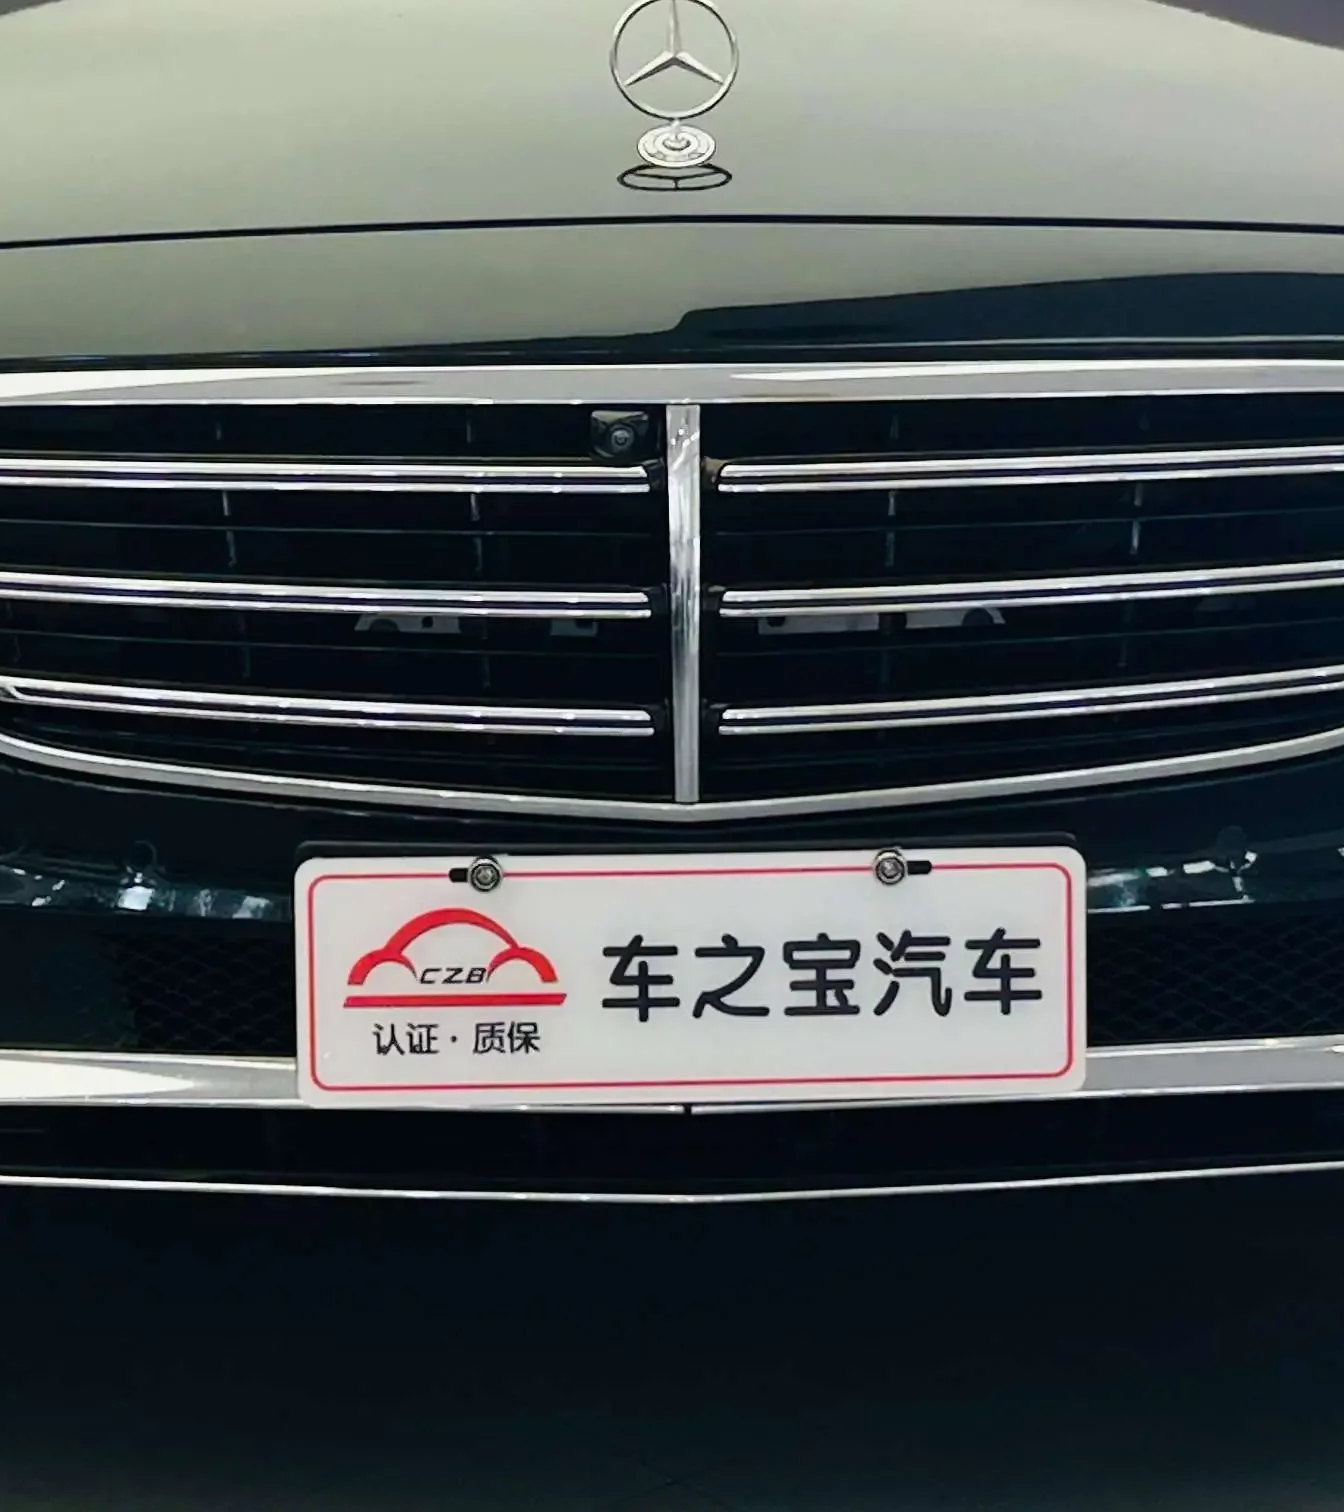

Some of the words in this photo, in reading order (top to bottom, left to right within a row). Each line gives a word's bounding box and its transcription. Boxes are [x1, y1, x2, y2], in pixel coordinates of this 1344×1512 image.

[419, 967, 487, 985] CZB
[601, 928, 1043, 1023] 车之宝汽车
